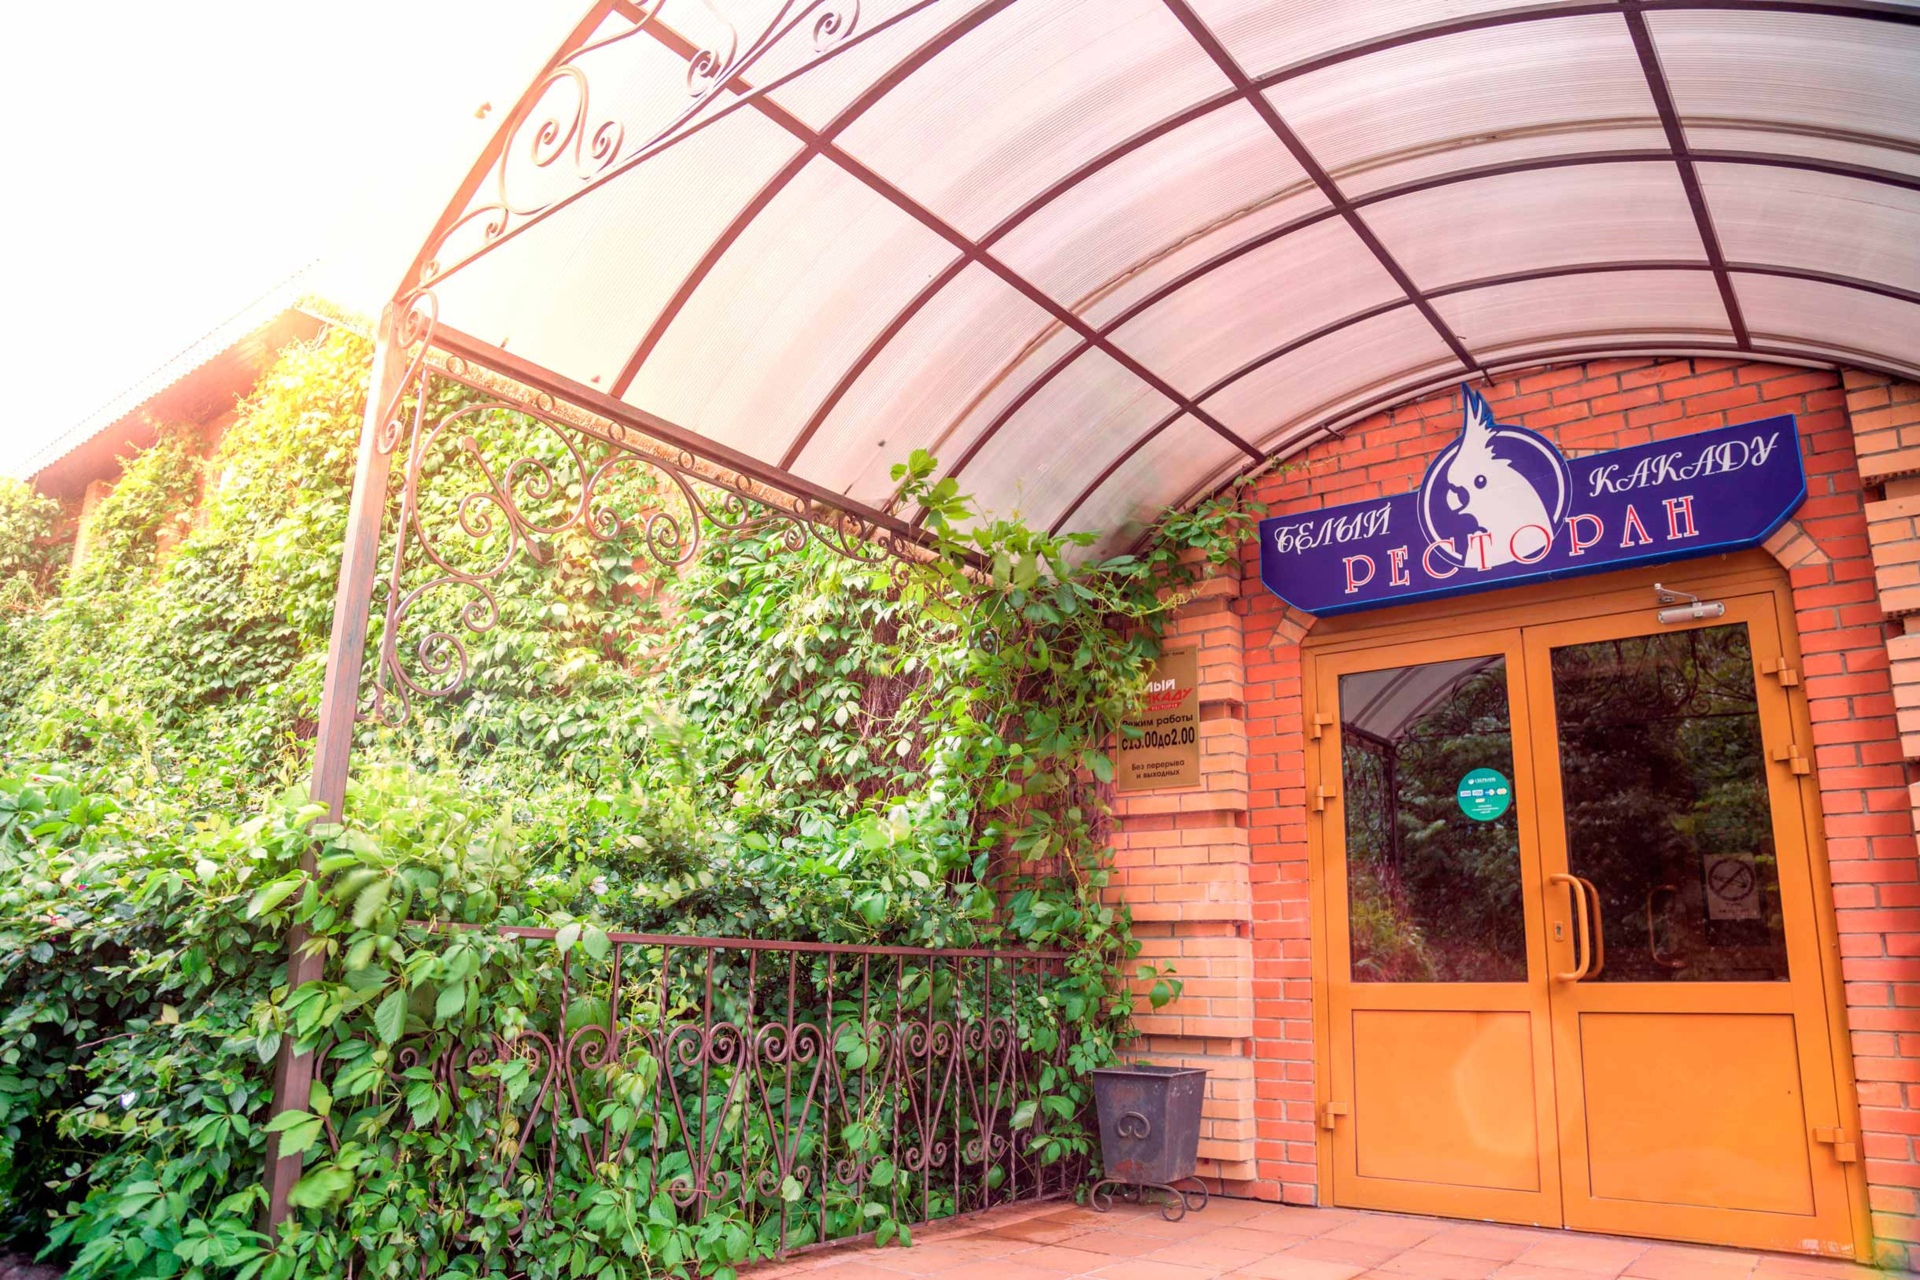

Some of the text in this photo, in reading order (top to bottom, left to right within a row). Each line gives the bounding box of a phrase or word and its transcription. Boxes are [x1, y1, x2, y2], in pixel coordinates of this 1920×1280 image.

[1274, 432, 1779, 554] БЕЛЫЙ КАКАДУ
[1342, 495, 1699, 594] РЕСТОРАН
[1156, 714, 1194, 727] работы
[1131, 759, 1185, 771] Без перерыва
[1143, 769, 1180, 779] выходных
